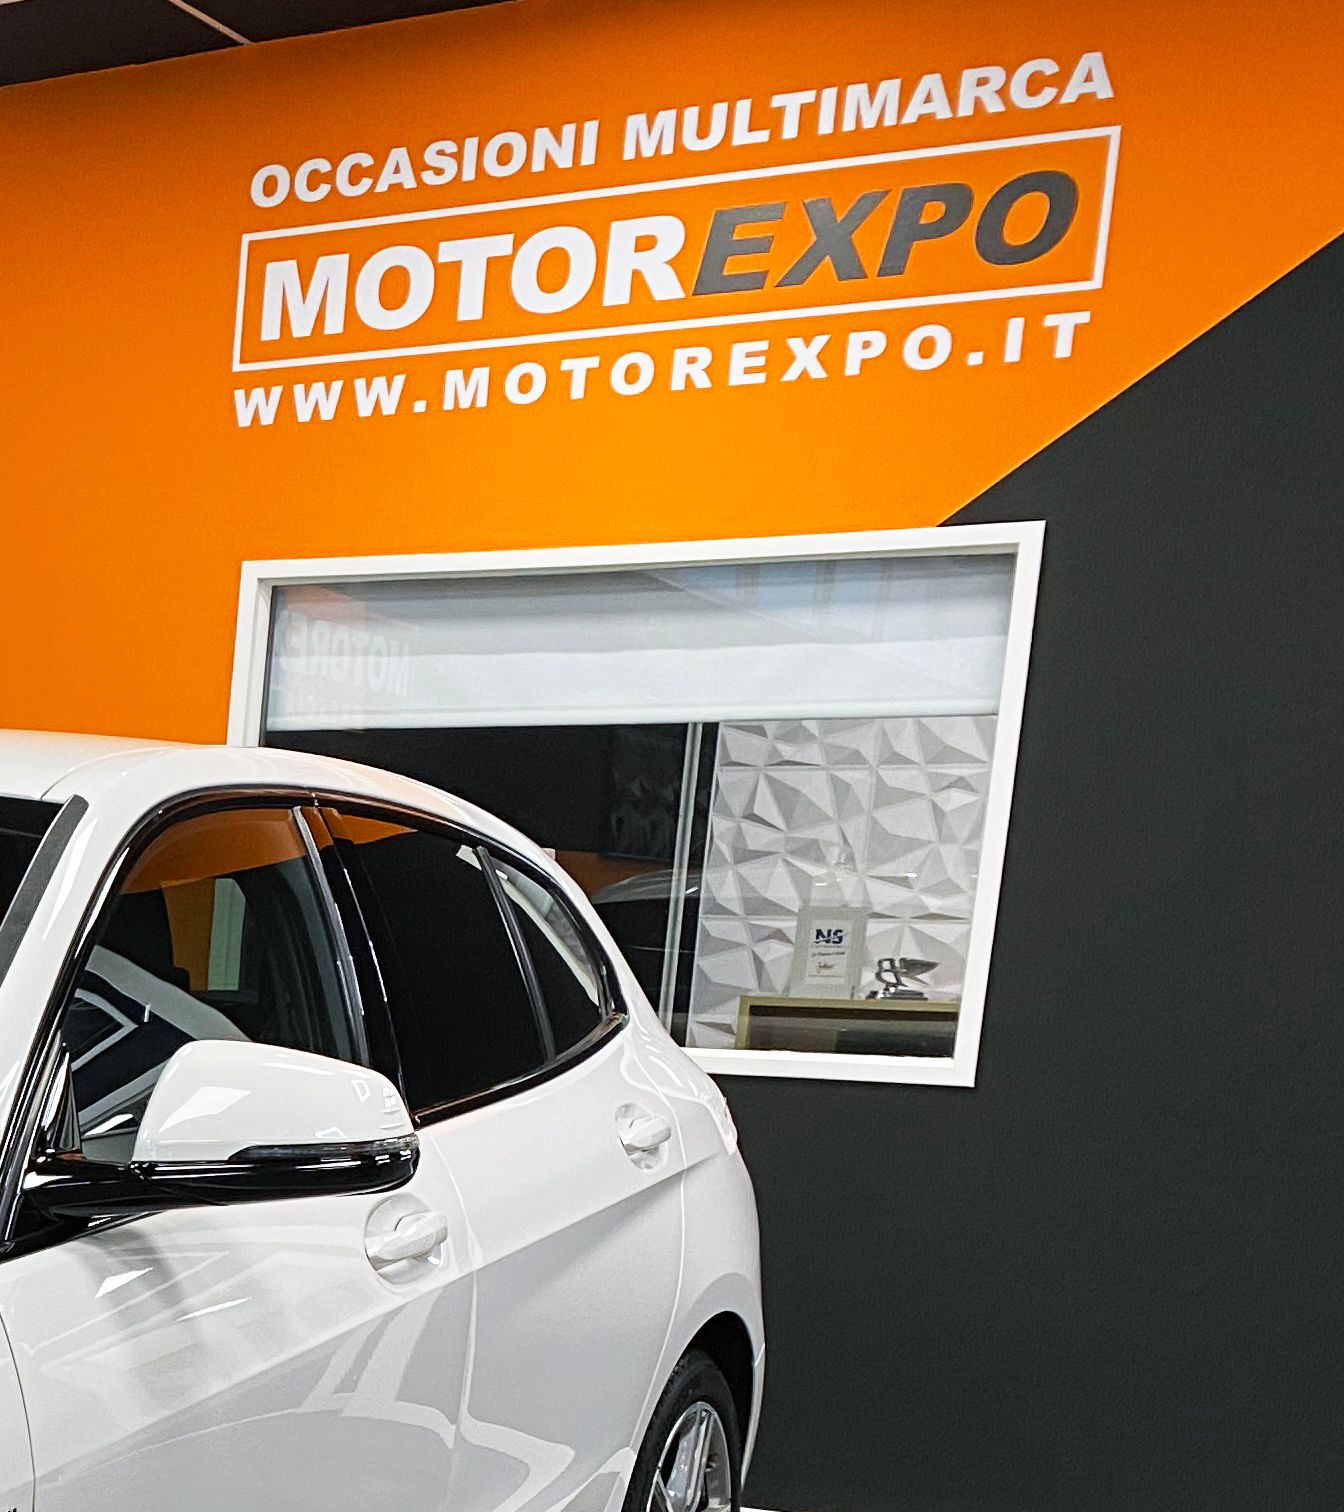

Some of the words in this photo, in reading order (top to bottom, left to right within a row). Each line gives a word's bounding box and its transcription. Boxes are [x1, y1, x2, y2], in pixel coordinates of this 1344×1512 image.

[249, 118, 598, 209] OCCASIONI
[621, 50, 1115, 161] MULTIMARCA
[258, 168, 1080, 343] MOTOREXPO
[232, 311, 1092, 428] WWW.MOTOREXPO.IT
